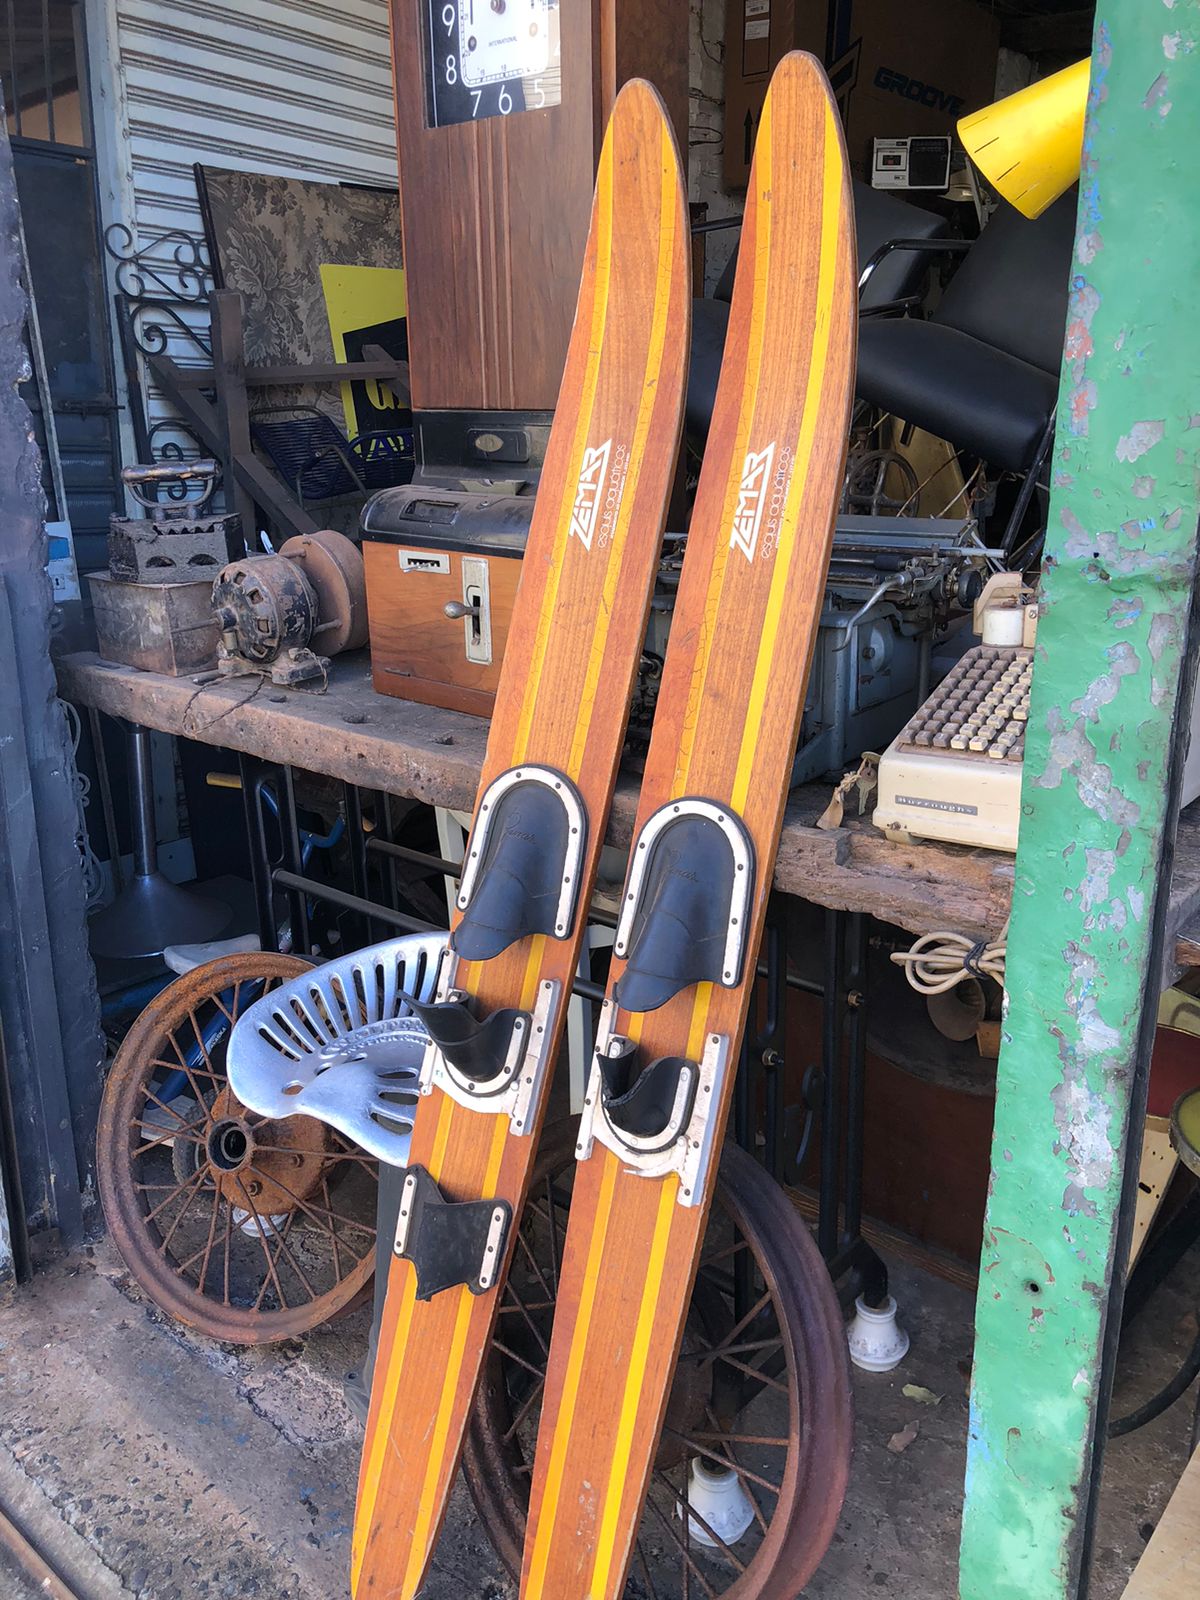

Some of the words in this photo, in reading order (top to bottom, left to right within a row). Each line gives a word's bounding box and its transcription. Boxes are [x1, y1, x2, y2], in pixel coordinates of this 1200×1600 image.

[442, 4, 456, 37] 9
[445, 54, 457, 85] 8
[470, 90, 482, 117] 7
[498, 84, 513, 115] 6
[533, 78, 545, 109] 5
[874, 67, 965, 118] GROOVE
[568, 438, 612, 552] ZEMAR
[730, 441, 776, 564] ZEMAR
